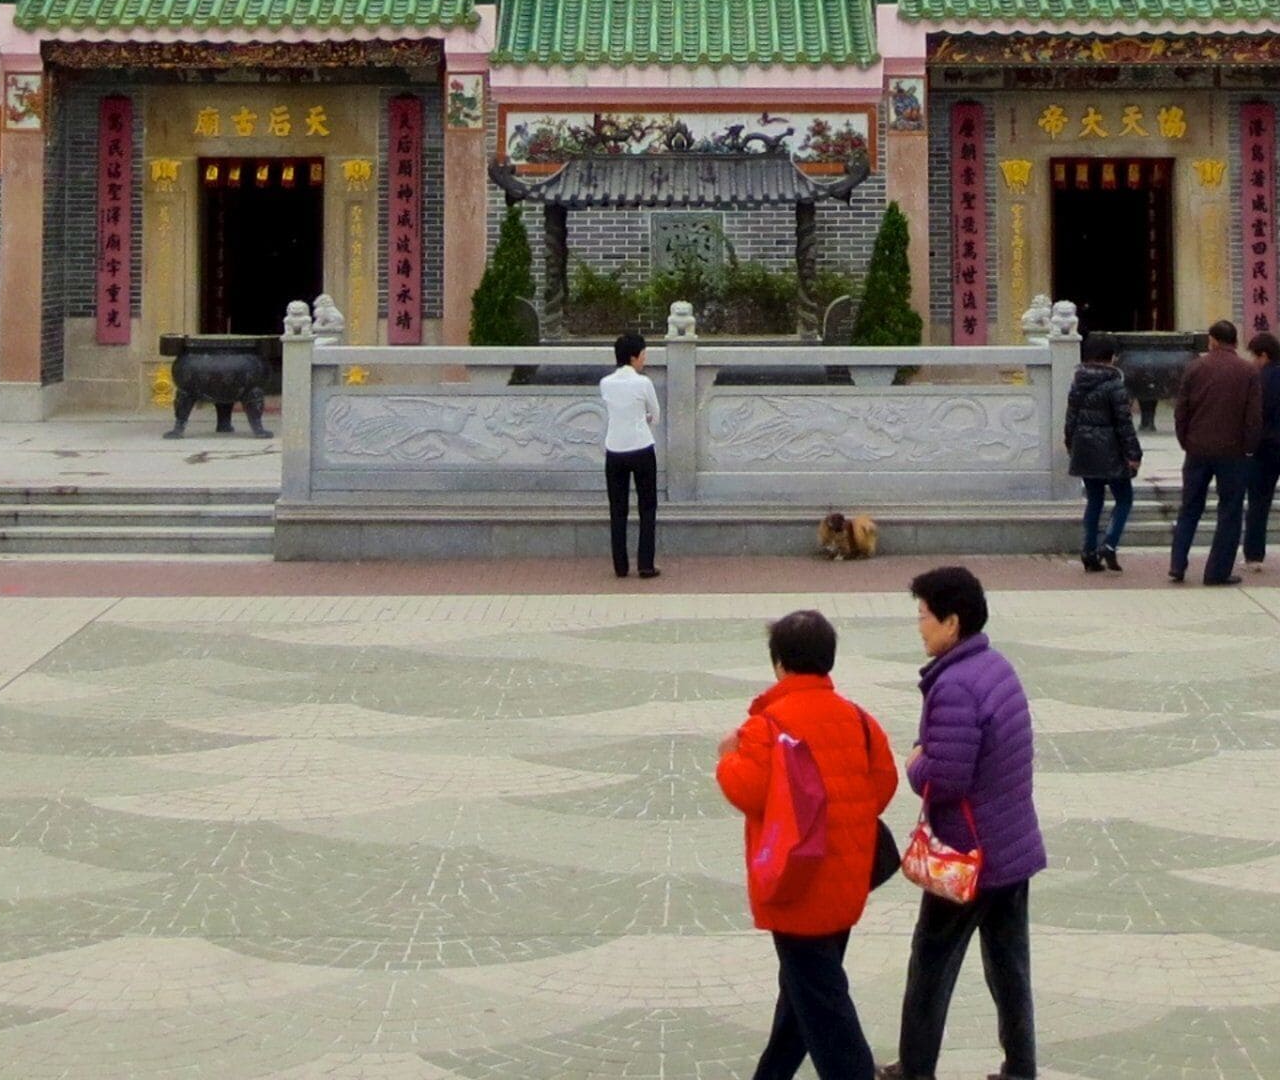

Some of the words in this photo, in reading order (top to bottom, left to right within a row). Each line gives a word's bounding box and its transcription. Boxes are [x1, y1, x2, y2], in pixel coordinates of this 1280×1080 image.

[193, 105, 331, 138] 天后古廟
[1038, 104, 1188, 140] 協天大帝
